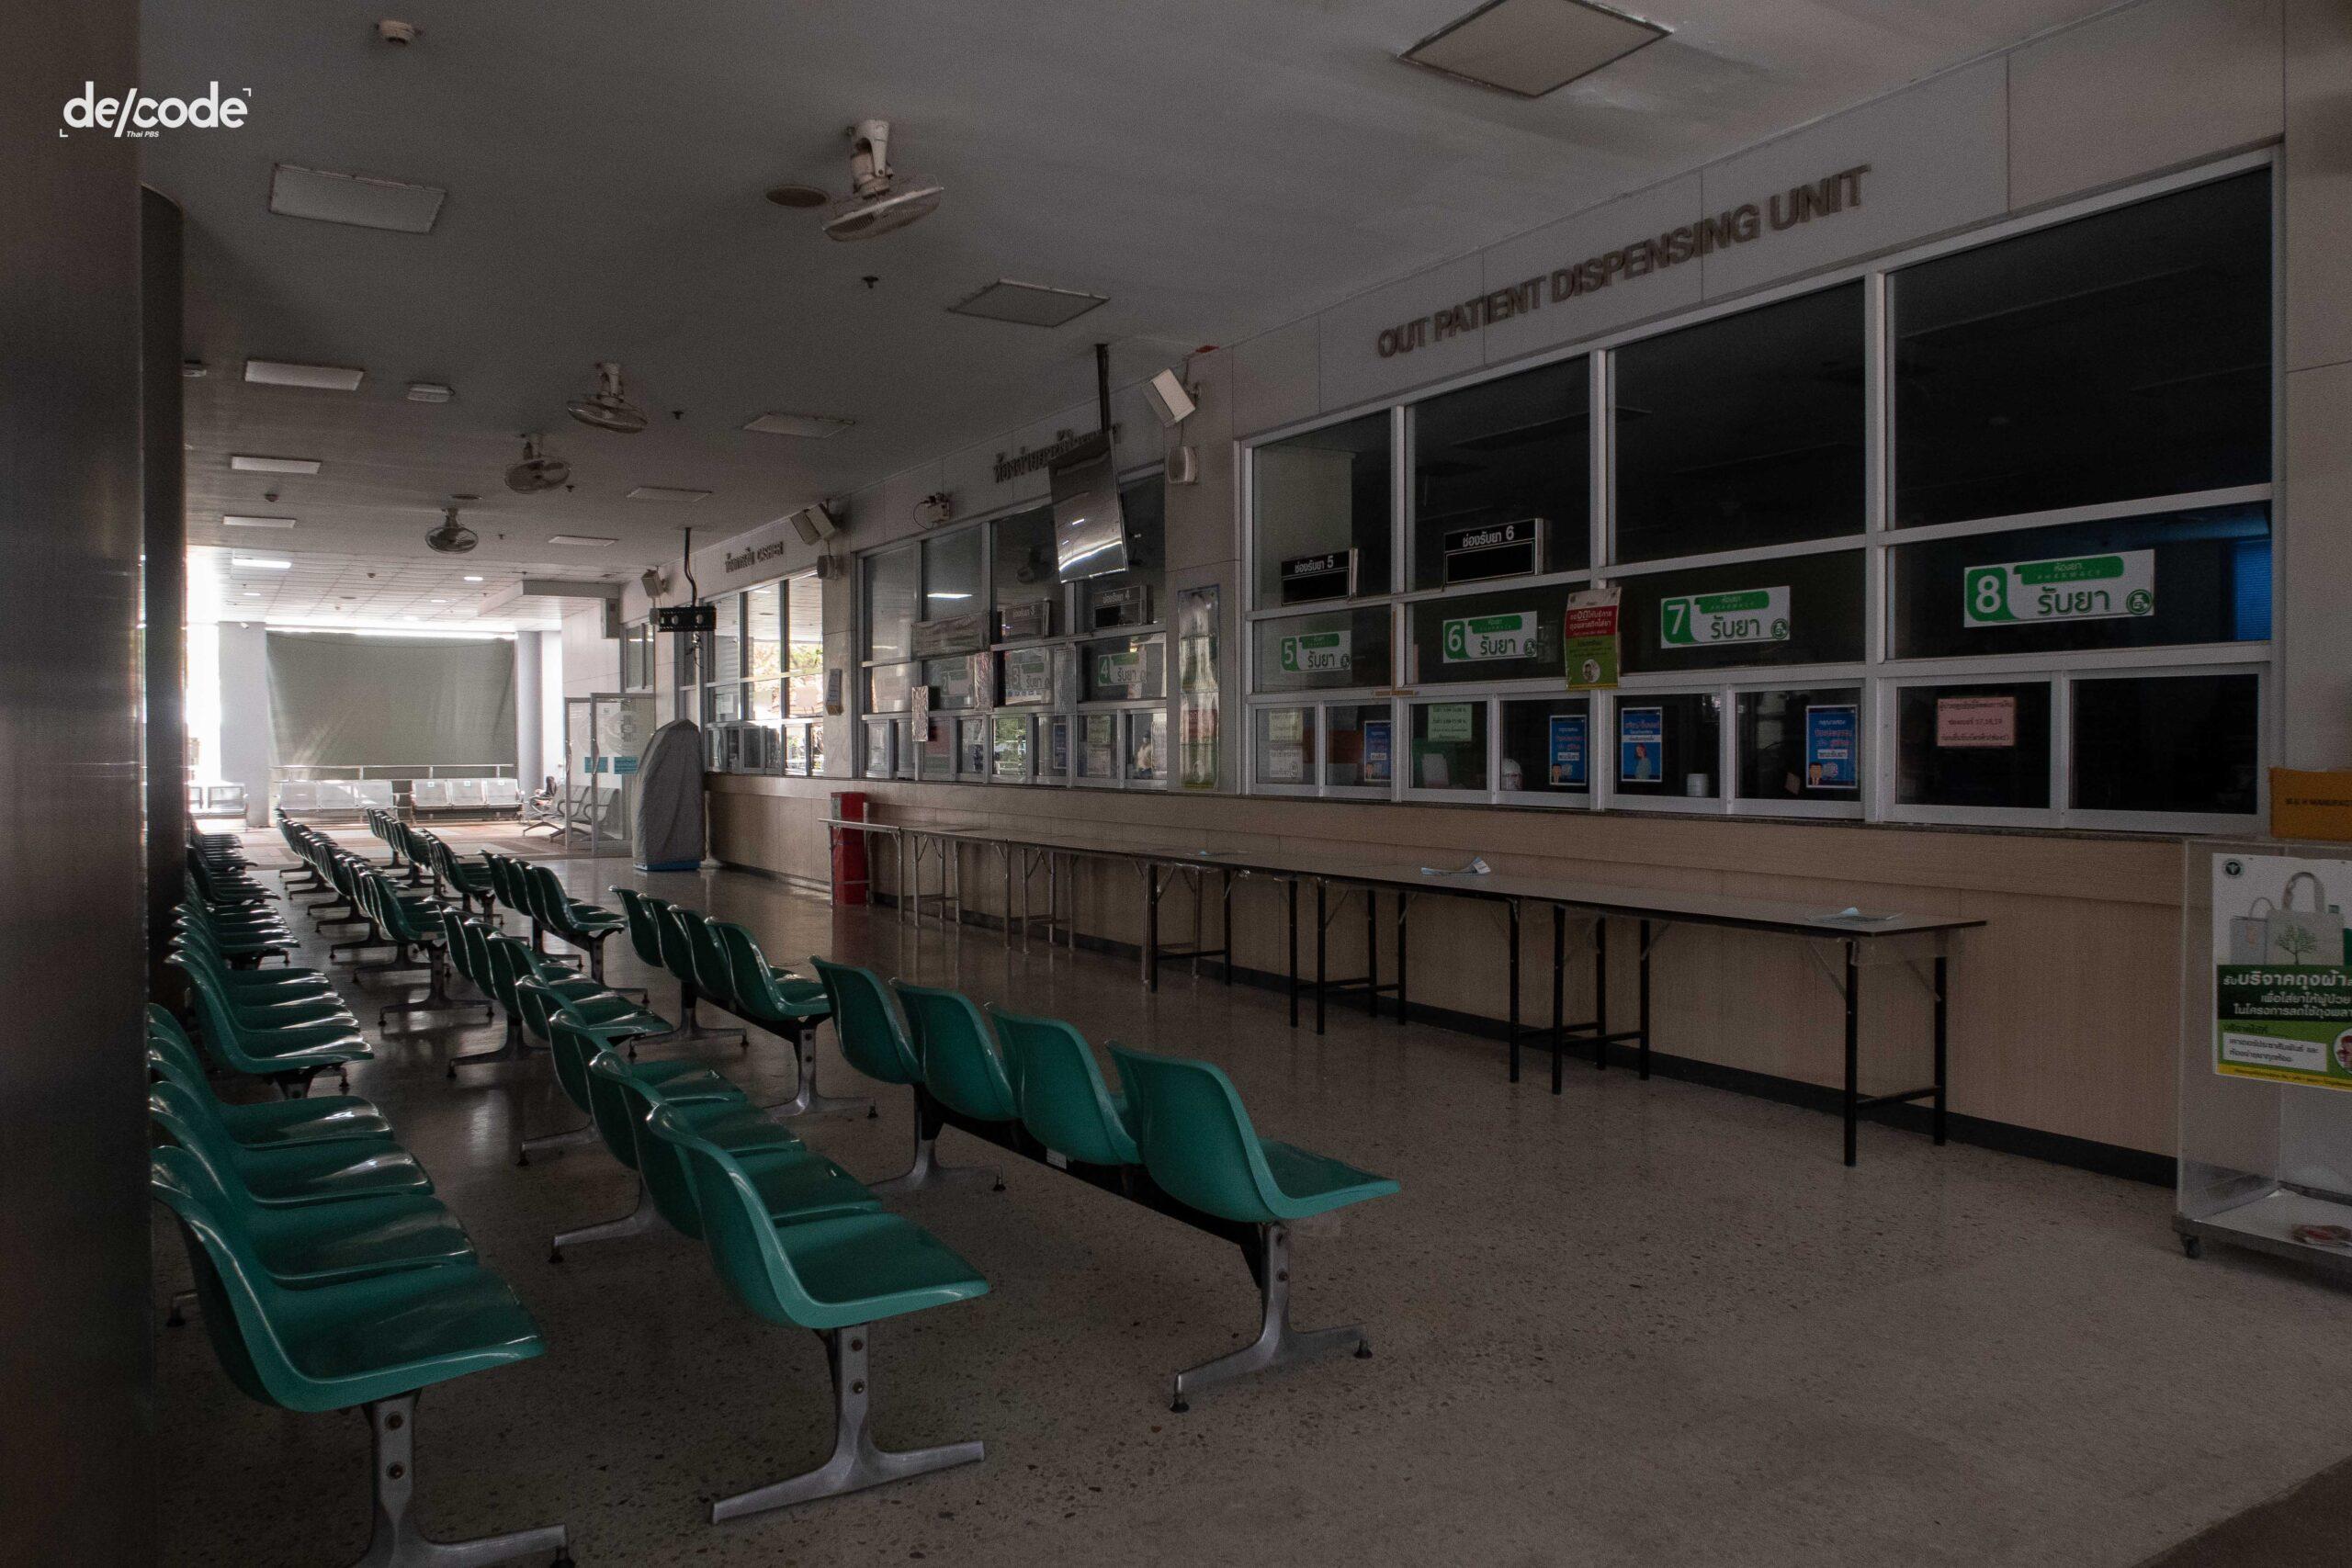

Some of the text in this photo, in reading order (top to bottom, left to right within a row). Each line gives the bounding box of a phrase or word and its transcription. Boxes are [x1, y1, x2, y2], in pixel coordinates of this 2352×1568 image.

[1377, 164, 1871, 359] OUT PATIENT DISPENSING UNIT
[1463, 525, 1515, 548] ช่องรับยา 6
[1327, 555, 1335, 569] 5
[1975, 574, 2002, 614] 8
[2038, 586, 2110, 616] รับยา
[1668, 604, 1687, 636] 7
[1711, 615, 1760, 639] รับยา
[1448, 625, 1462, 652] 6
[1480, 636, 1516, 655] รับยา
[1284, 641, 1295, 664] 5
[1307, 650, 1335, 668] รับยา
[1100, 660, 1109, 679] 4
